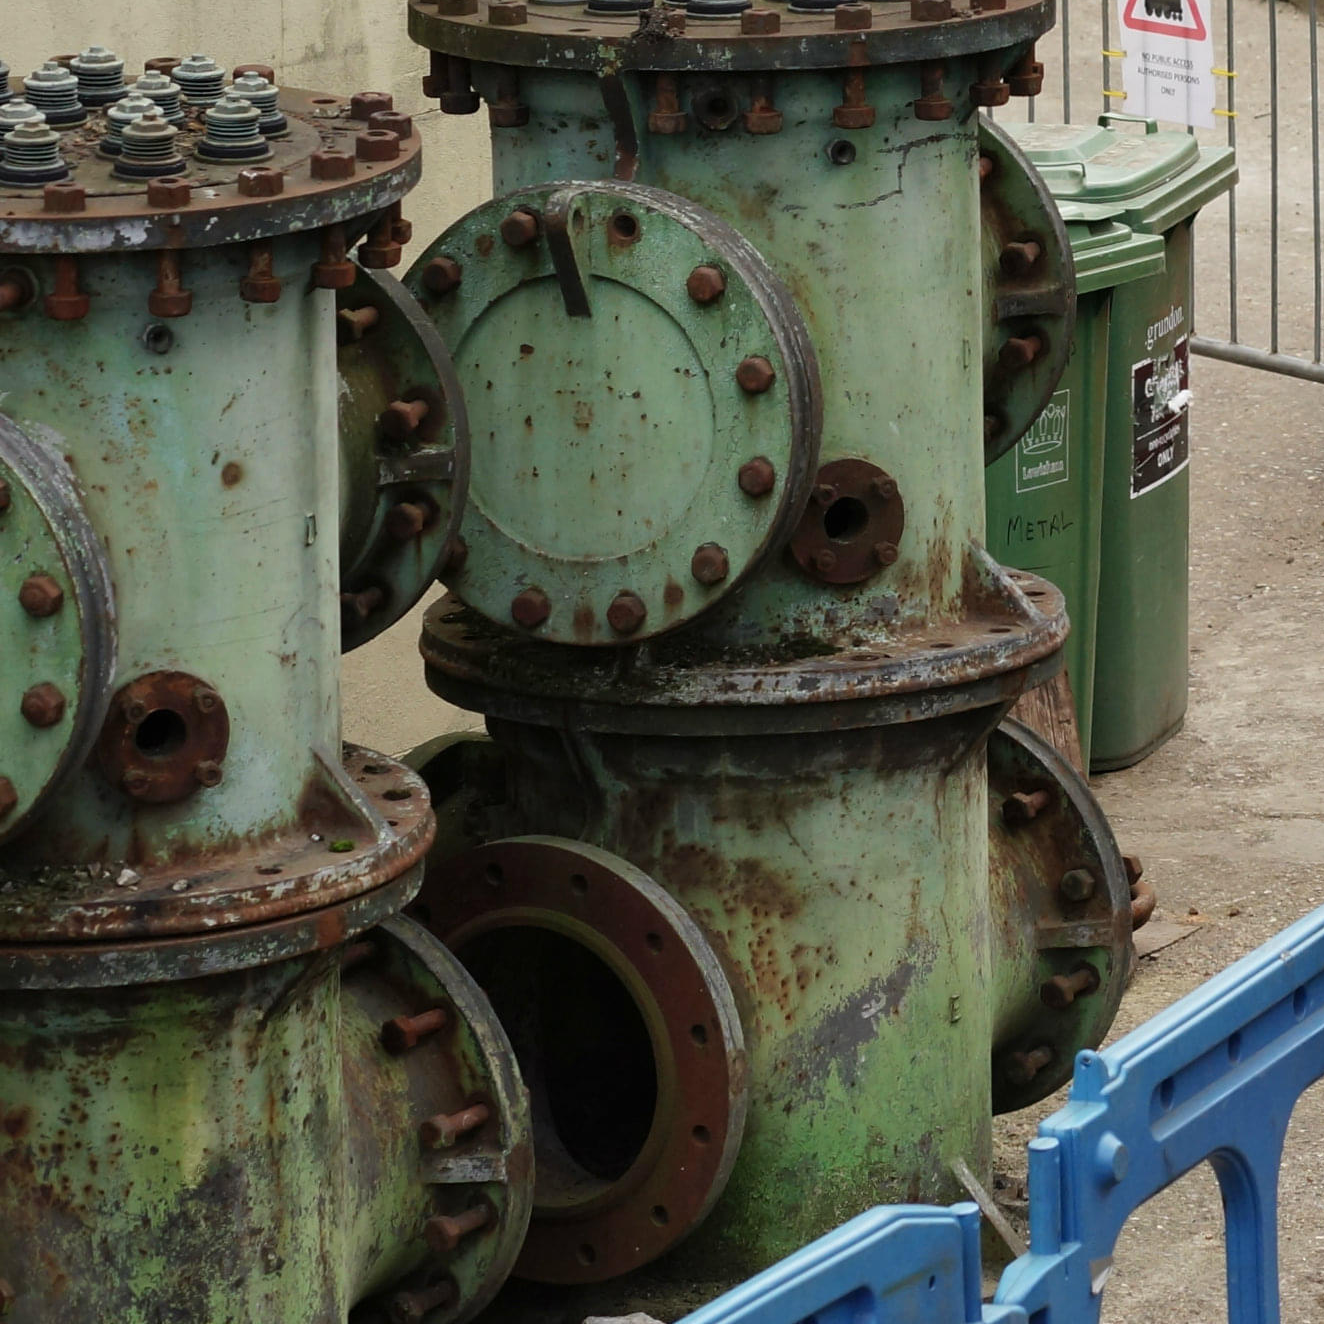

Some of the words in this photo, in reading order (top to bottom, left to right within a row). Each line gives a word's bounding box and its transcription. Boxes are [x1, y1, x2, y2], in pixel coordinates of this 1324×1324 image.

[1151, 53, 1171, 65] PUBLIC
[1172, 57, 1193, 69] ACCESS
[1173, 73, 1200, 84] PERSONS
[1160, 86, 1175, 96] ONLY
[1157, 443, 1175, 467] ONLY
[1007, 509, 1074, 546] METAL
